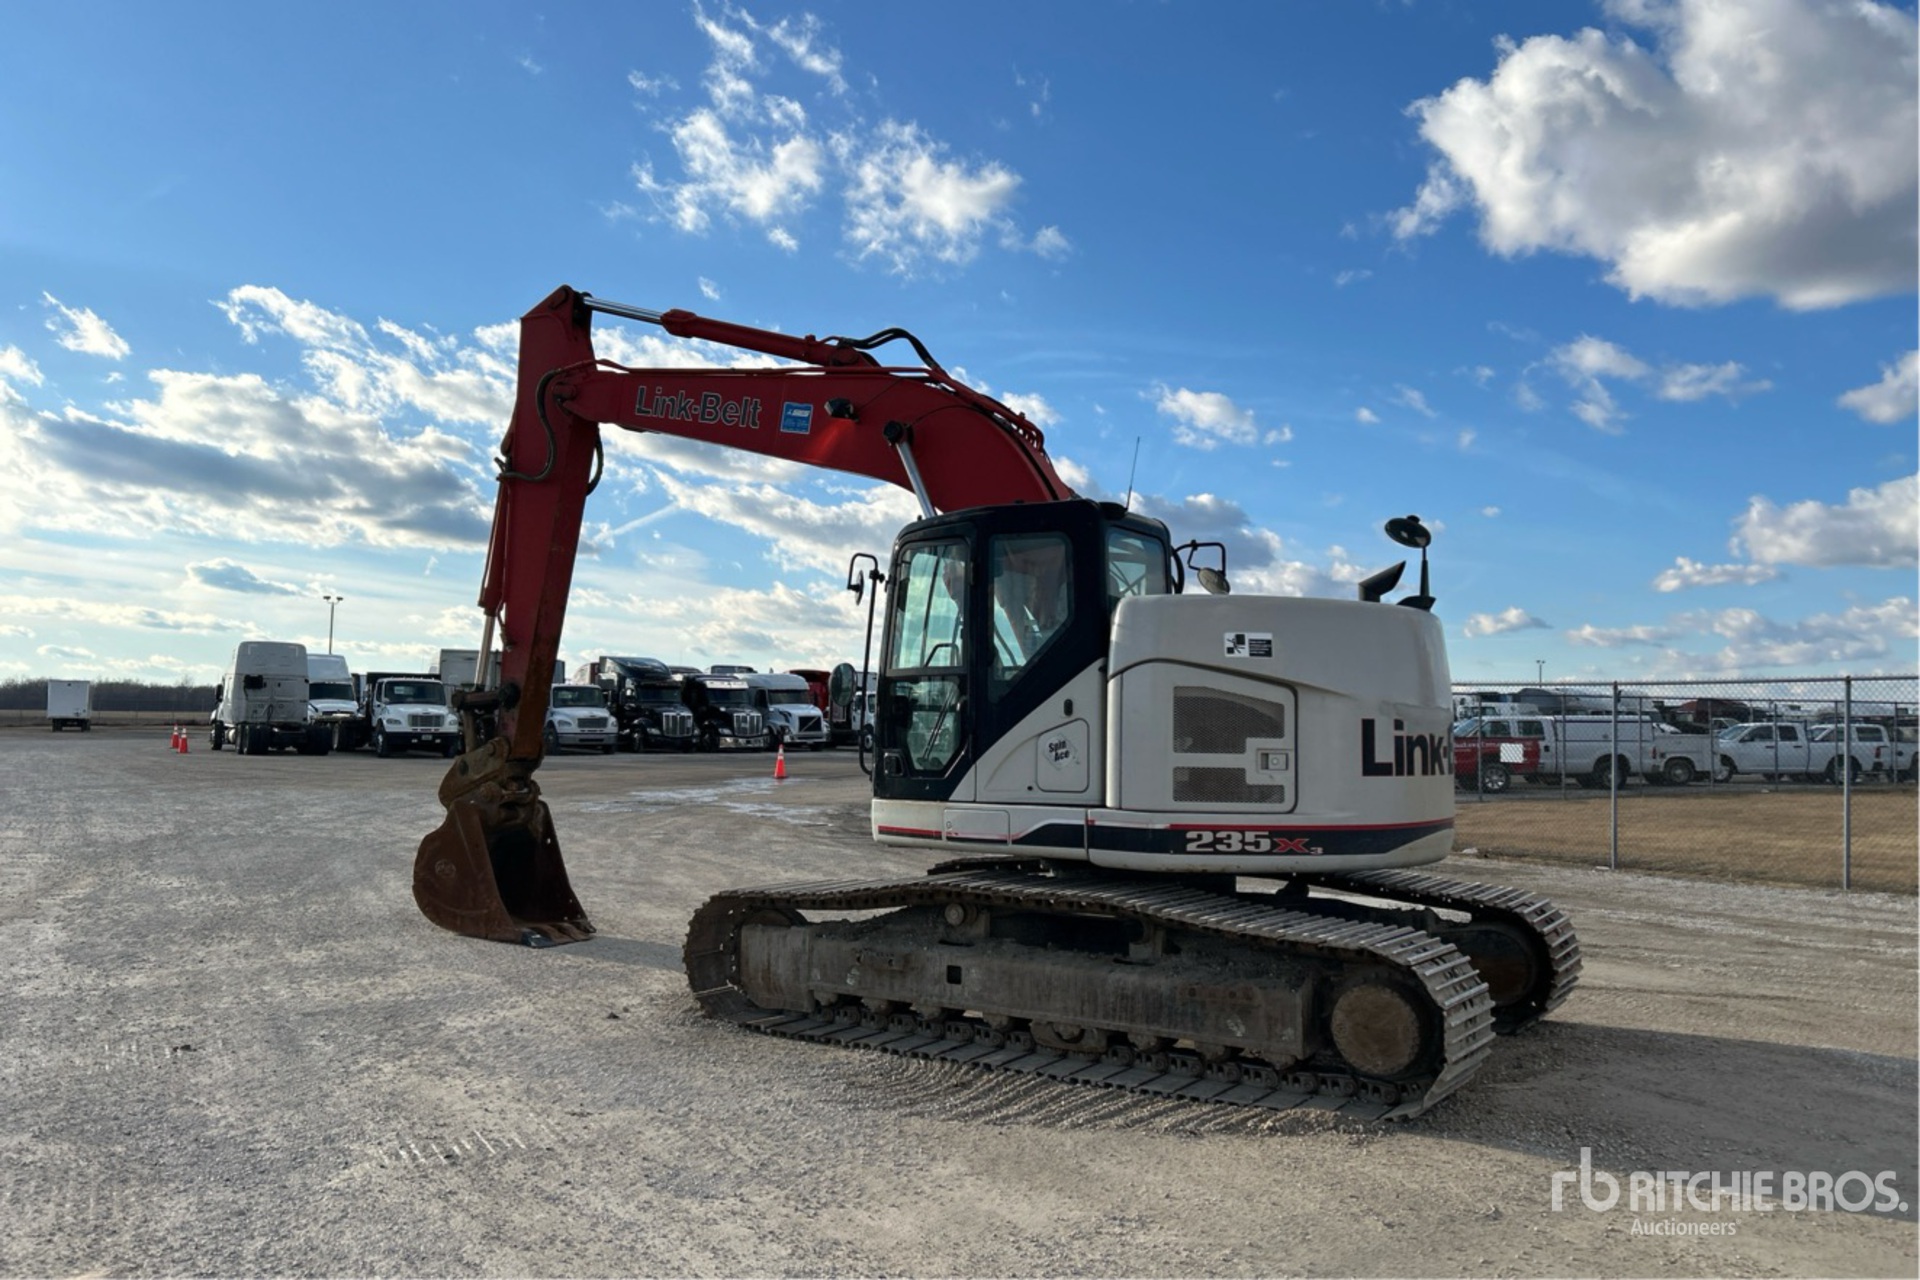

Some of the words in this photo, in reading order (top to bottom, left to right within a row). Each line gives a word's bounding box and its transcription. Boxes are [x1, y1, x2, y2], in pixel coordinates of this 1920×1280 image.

[635, 385, 762, 428] Link-Belt
[1048, 740, 1067, 753] Spin
[1054, 750, 1070, 762] Ace
